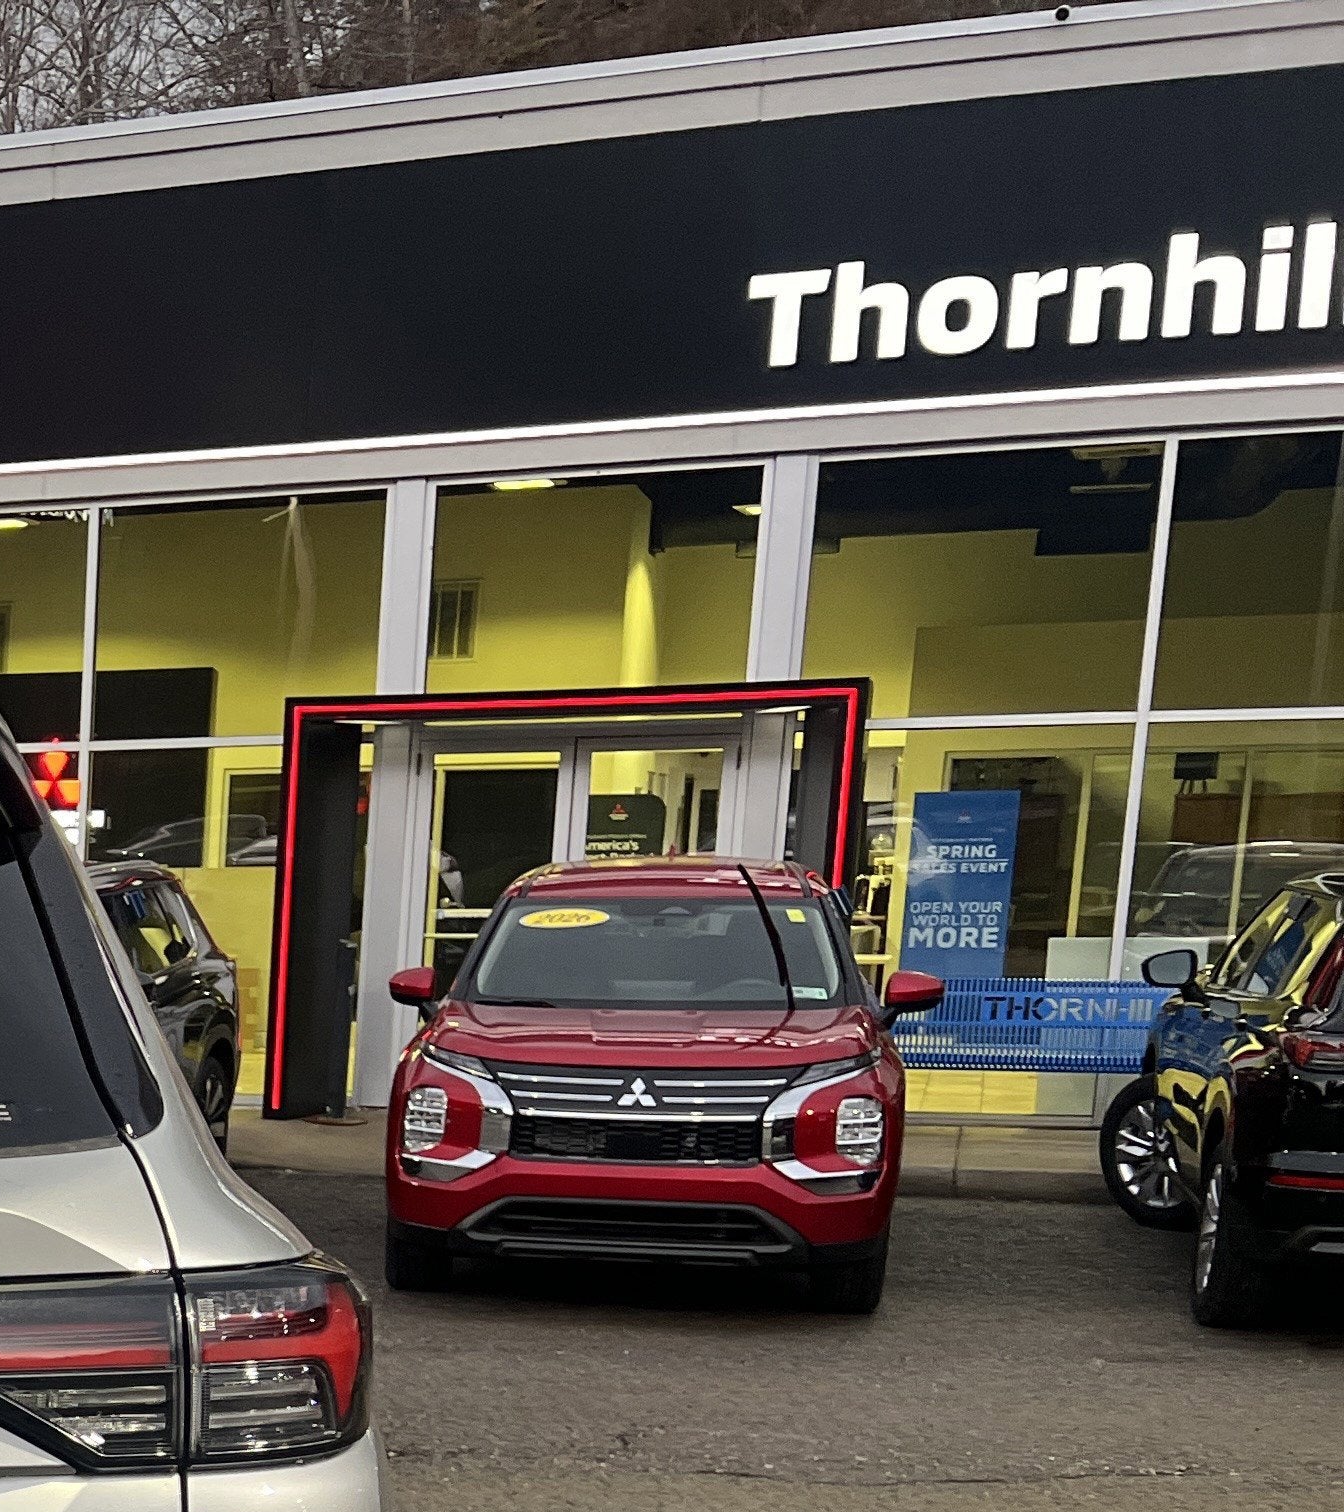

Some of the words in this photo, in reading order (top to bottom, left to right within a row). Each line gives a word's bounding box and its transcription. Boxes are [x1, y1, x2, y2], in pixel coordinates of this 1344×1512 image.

[747, 220, 1344, 367] Thornhil
[926, 844, 997, 858] SPRING
[961, 862, 1009, 873] EVENT
[910, 901, 953, 914] OPEN
[959, 901, 1003, 913] YOUR
[913, 914, 971, 926] WORLD
[977, 914, 998, 926] TO
[907, 926, 1000, 949] MORE
